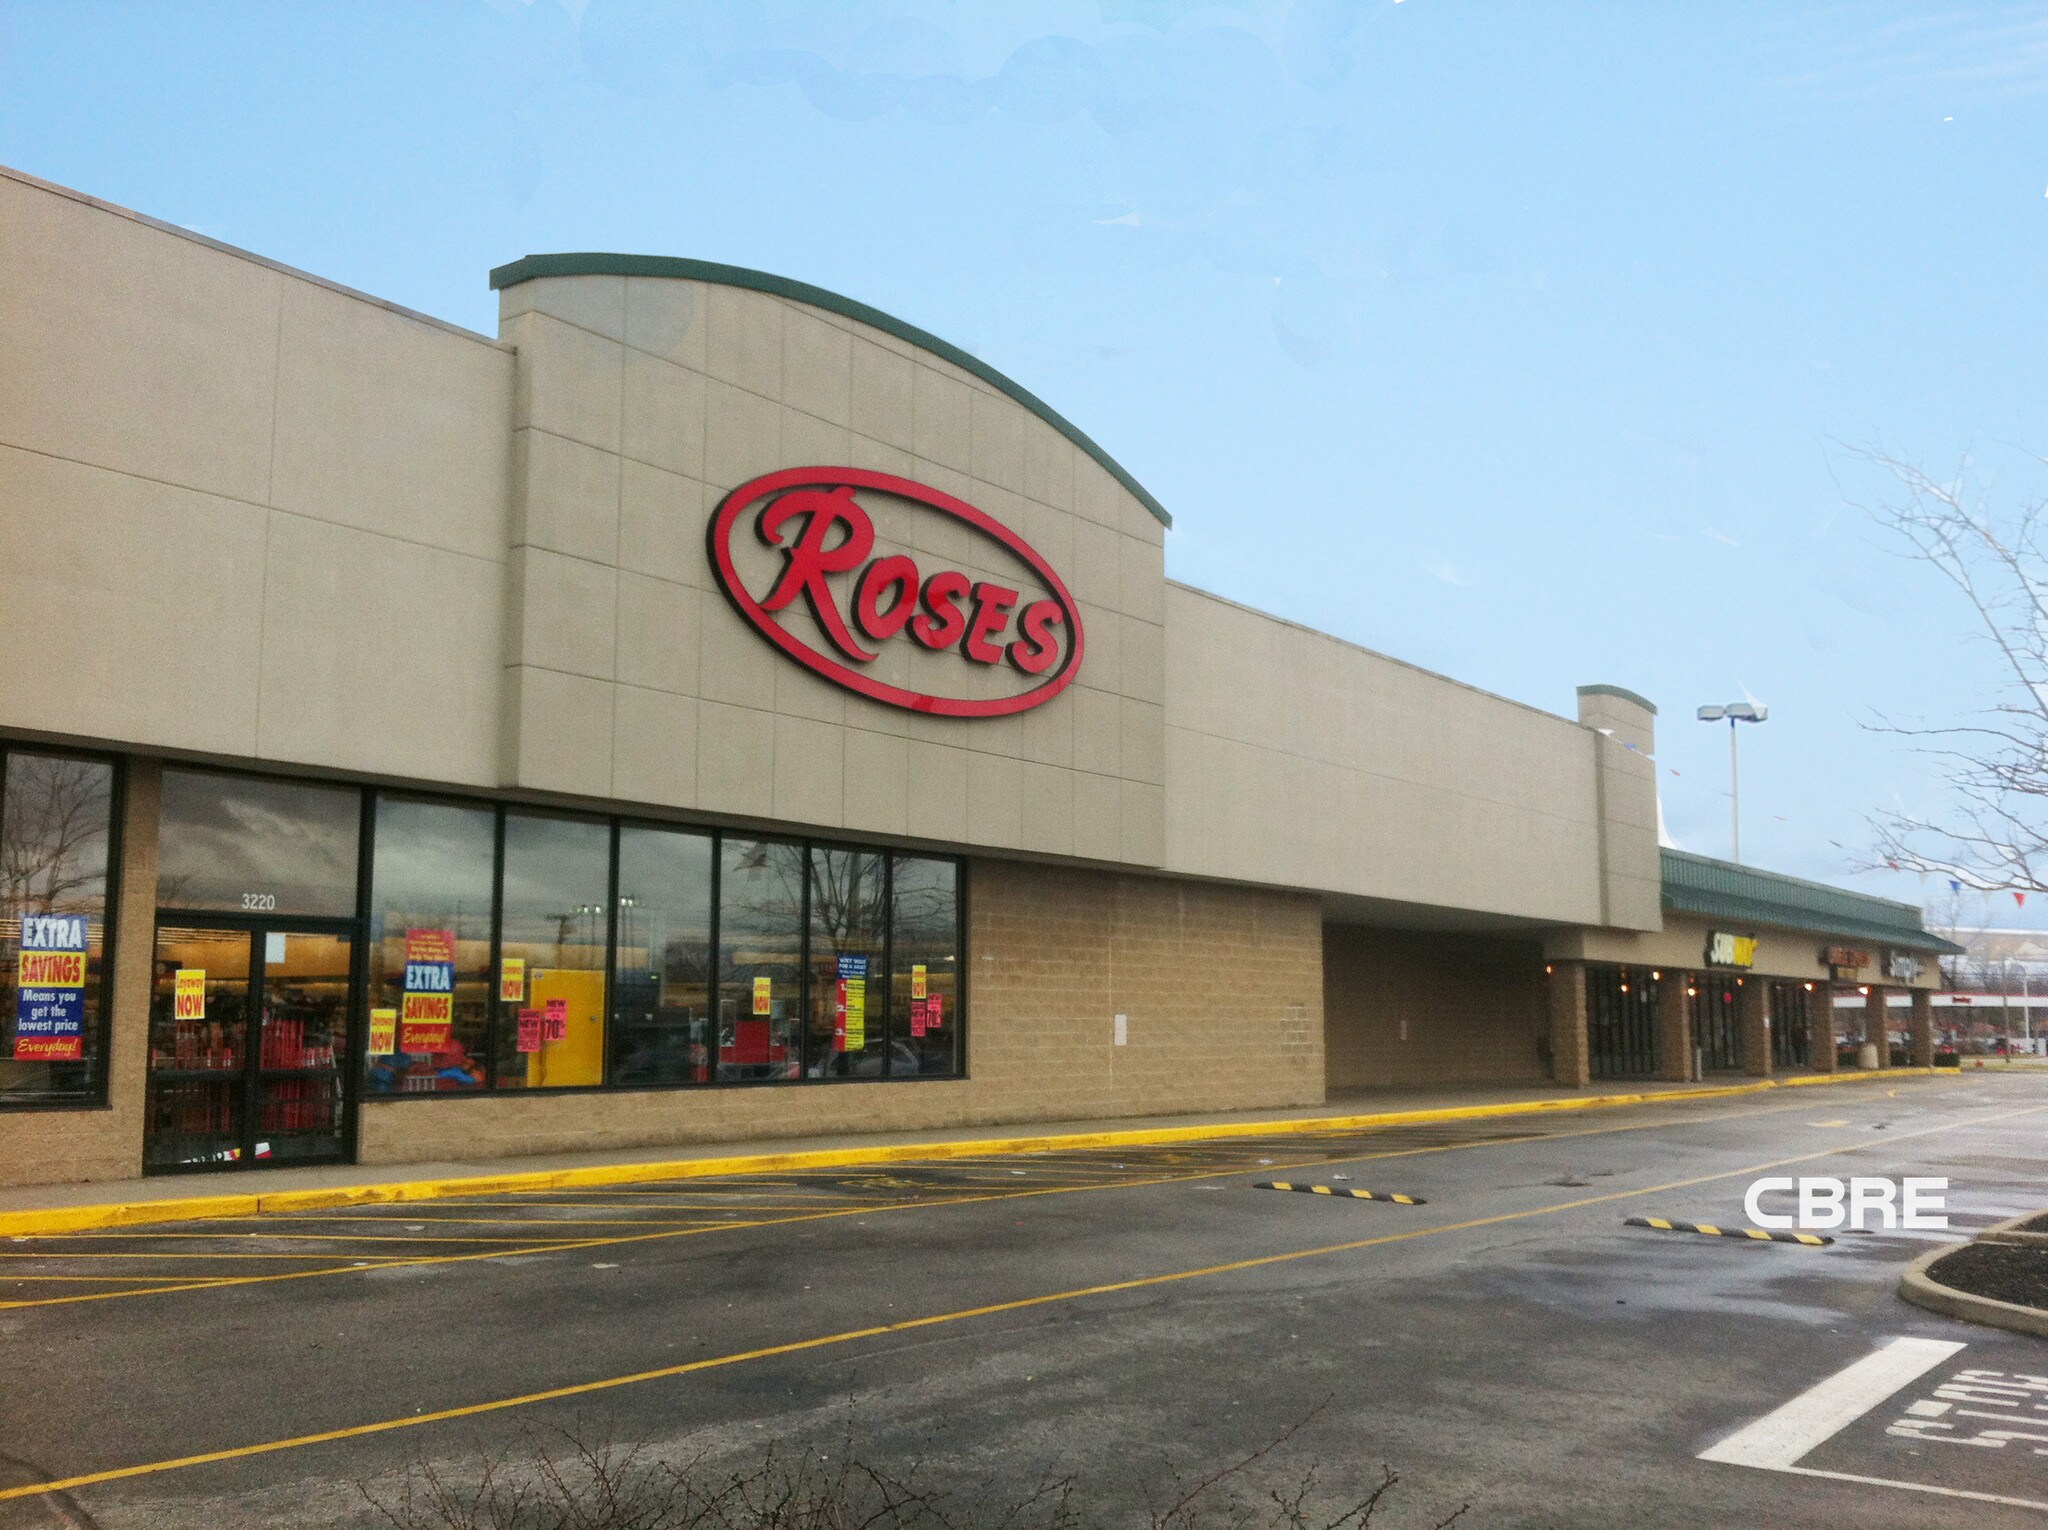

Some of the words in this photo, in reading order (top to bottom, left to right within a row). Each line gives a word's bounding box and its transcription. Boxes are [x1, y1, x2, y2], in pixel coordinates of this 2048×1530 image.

[241, 893, 275, 911] 3220
[22, 917, 82, 948] EXTRA
[21, 954, 81, 983] SAVINGS
[406, 965, 450, 990] EXTRA
[22, 989, 55, 1002] Means
[58, 992, 77, 1005] you
[177, 994, 203, 1017] NOW
[405, 996, 449, 1019] SAVINGS
[31, 1006, 48, 1020] get
[51, 1003, 67, 1017] the
[18, 1018, 52, 1031] lowest
[54, 1019, 78, 1034] price
[16, 1037, 78, 1056] Everyday!
